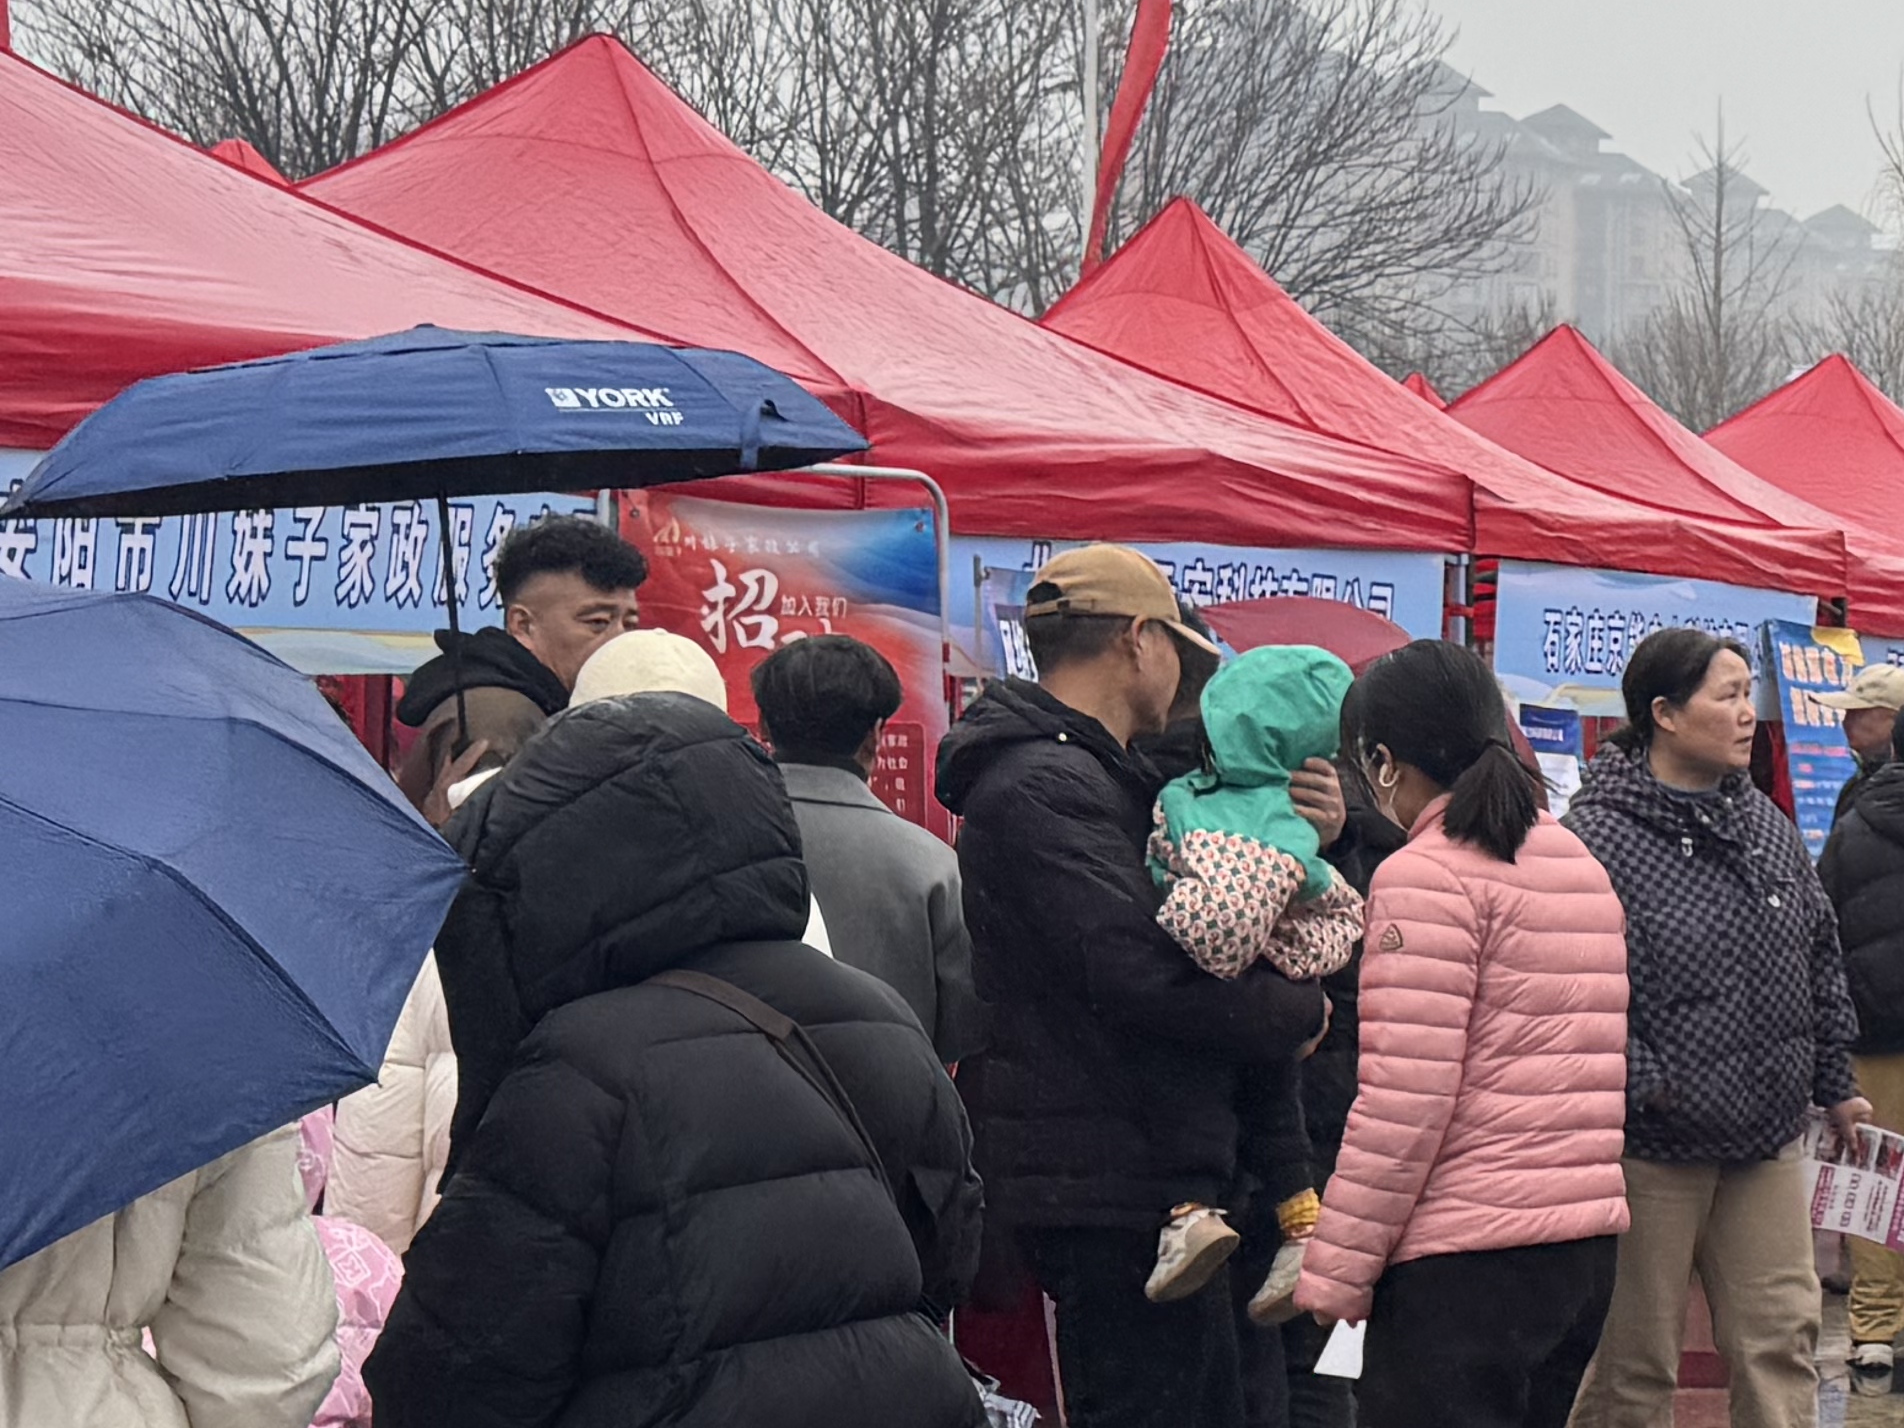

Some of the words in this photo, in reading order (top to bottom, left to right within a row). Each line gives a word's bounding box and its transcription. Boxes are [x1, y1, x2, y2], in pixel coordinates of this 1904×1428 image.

[573, 387, 674, 408] YORK
[645, 411, 684, 425] VRF
[780, 595, 847, 618] 加入我们
